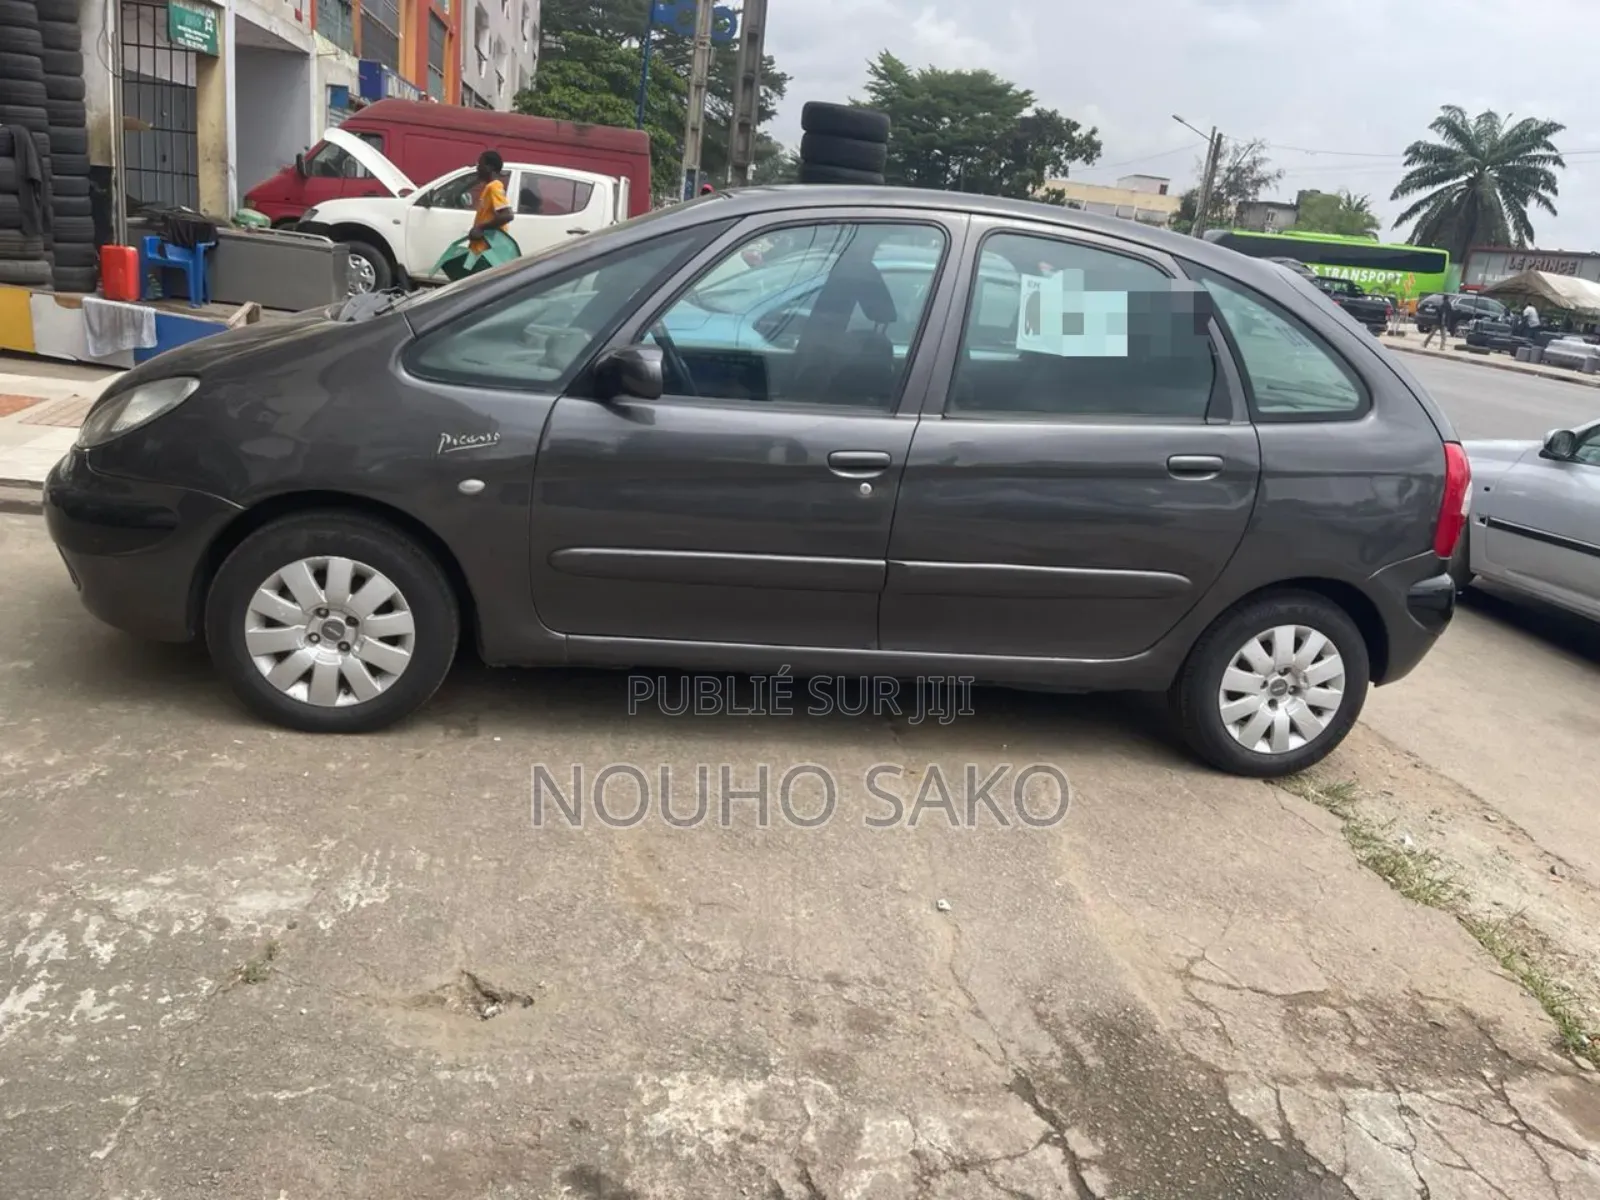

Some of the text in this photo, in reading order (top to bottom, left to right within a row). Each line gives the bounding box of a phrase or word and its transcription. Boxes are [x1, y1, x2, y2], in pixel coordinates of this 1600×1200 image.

[1508, 256, 1577, 275] LE PRINCE
[1324, 267, 1403, 285] TRANSPORT
